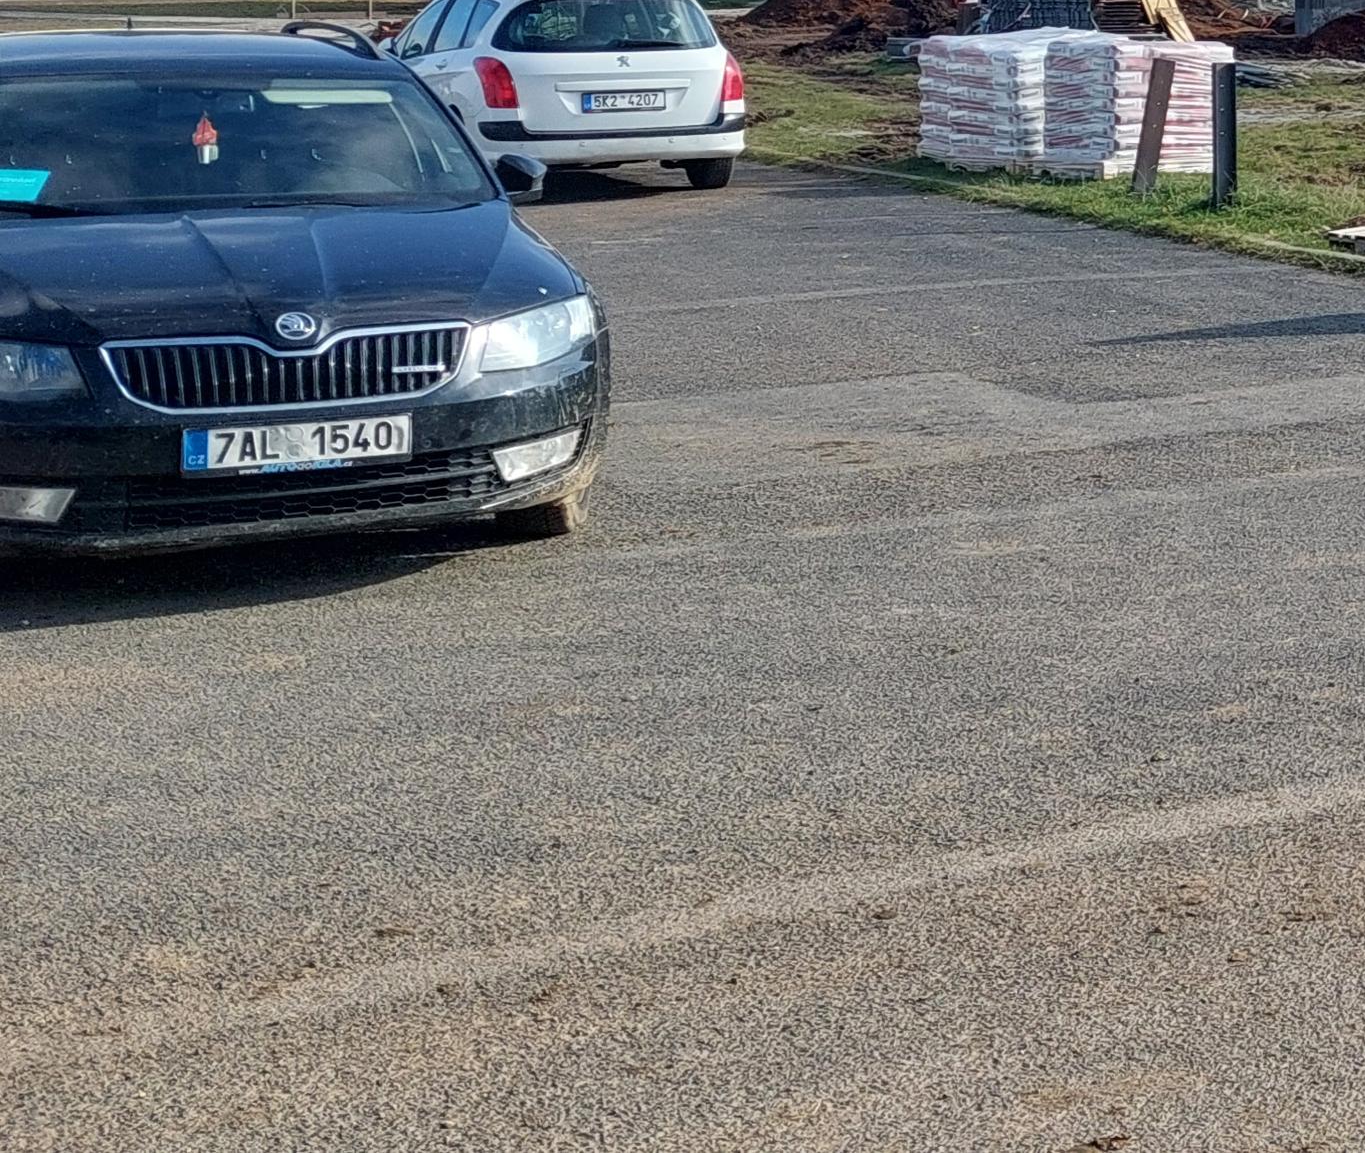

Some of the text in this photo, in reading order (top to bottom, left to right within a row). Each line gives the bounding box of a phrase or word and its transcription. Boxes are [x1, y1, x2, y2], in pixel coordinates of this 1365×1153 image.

[594, 93, 658, 108] 5K2 4207
[215, 421, 393, 464] 7AL 1540
[188, 455, 205, 466] CZ
